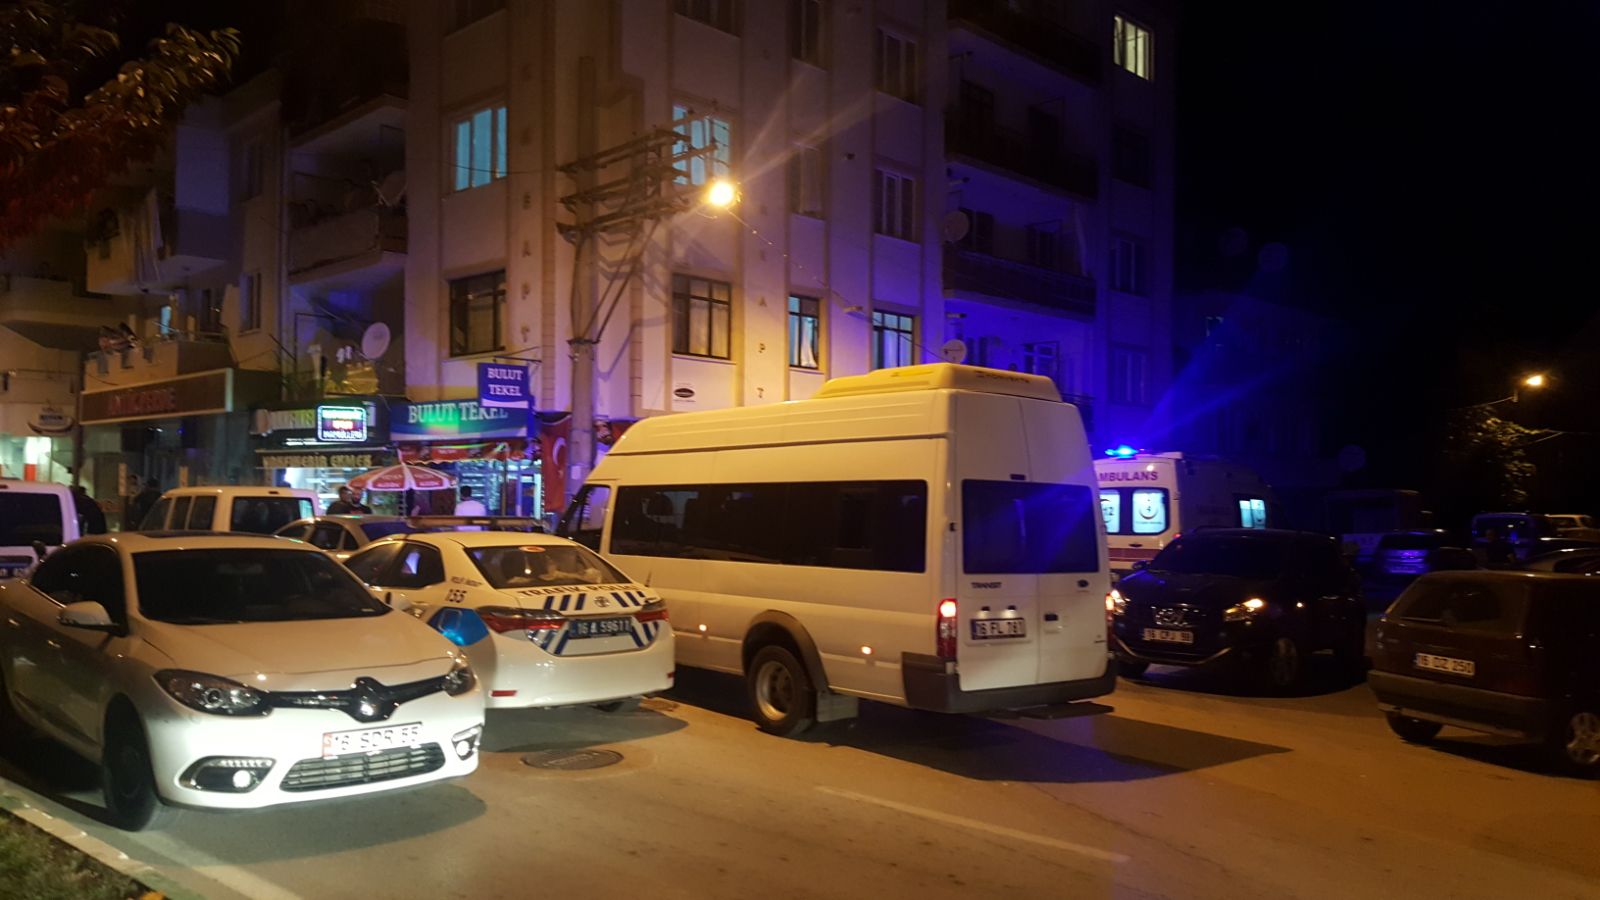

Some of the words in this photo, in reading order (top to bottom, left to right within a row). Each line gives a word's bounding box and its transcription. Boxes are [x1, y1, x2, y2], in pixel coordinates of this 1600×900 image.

[487, 367, 523, 381] BULUT
[488, 384, 522, 396] TEKEL
[408, 403, 457, 424] BULUT
[458, 402, 508, 421] TEKEL
[1100, 471, 1158, 482] MBULANS
